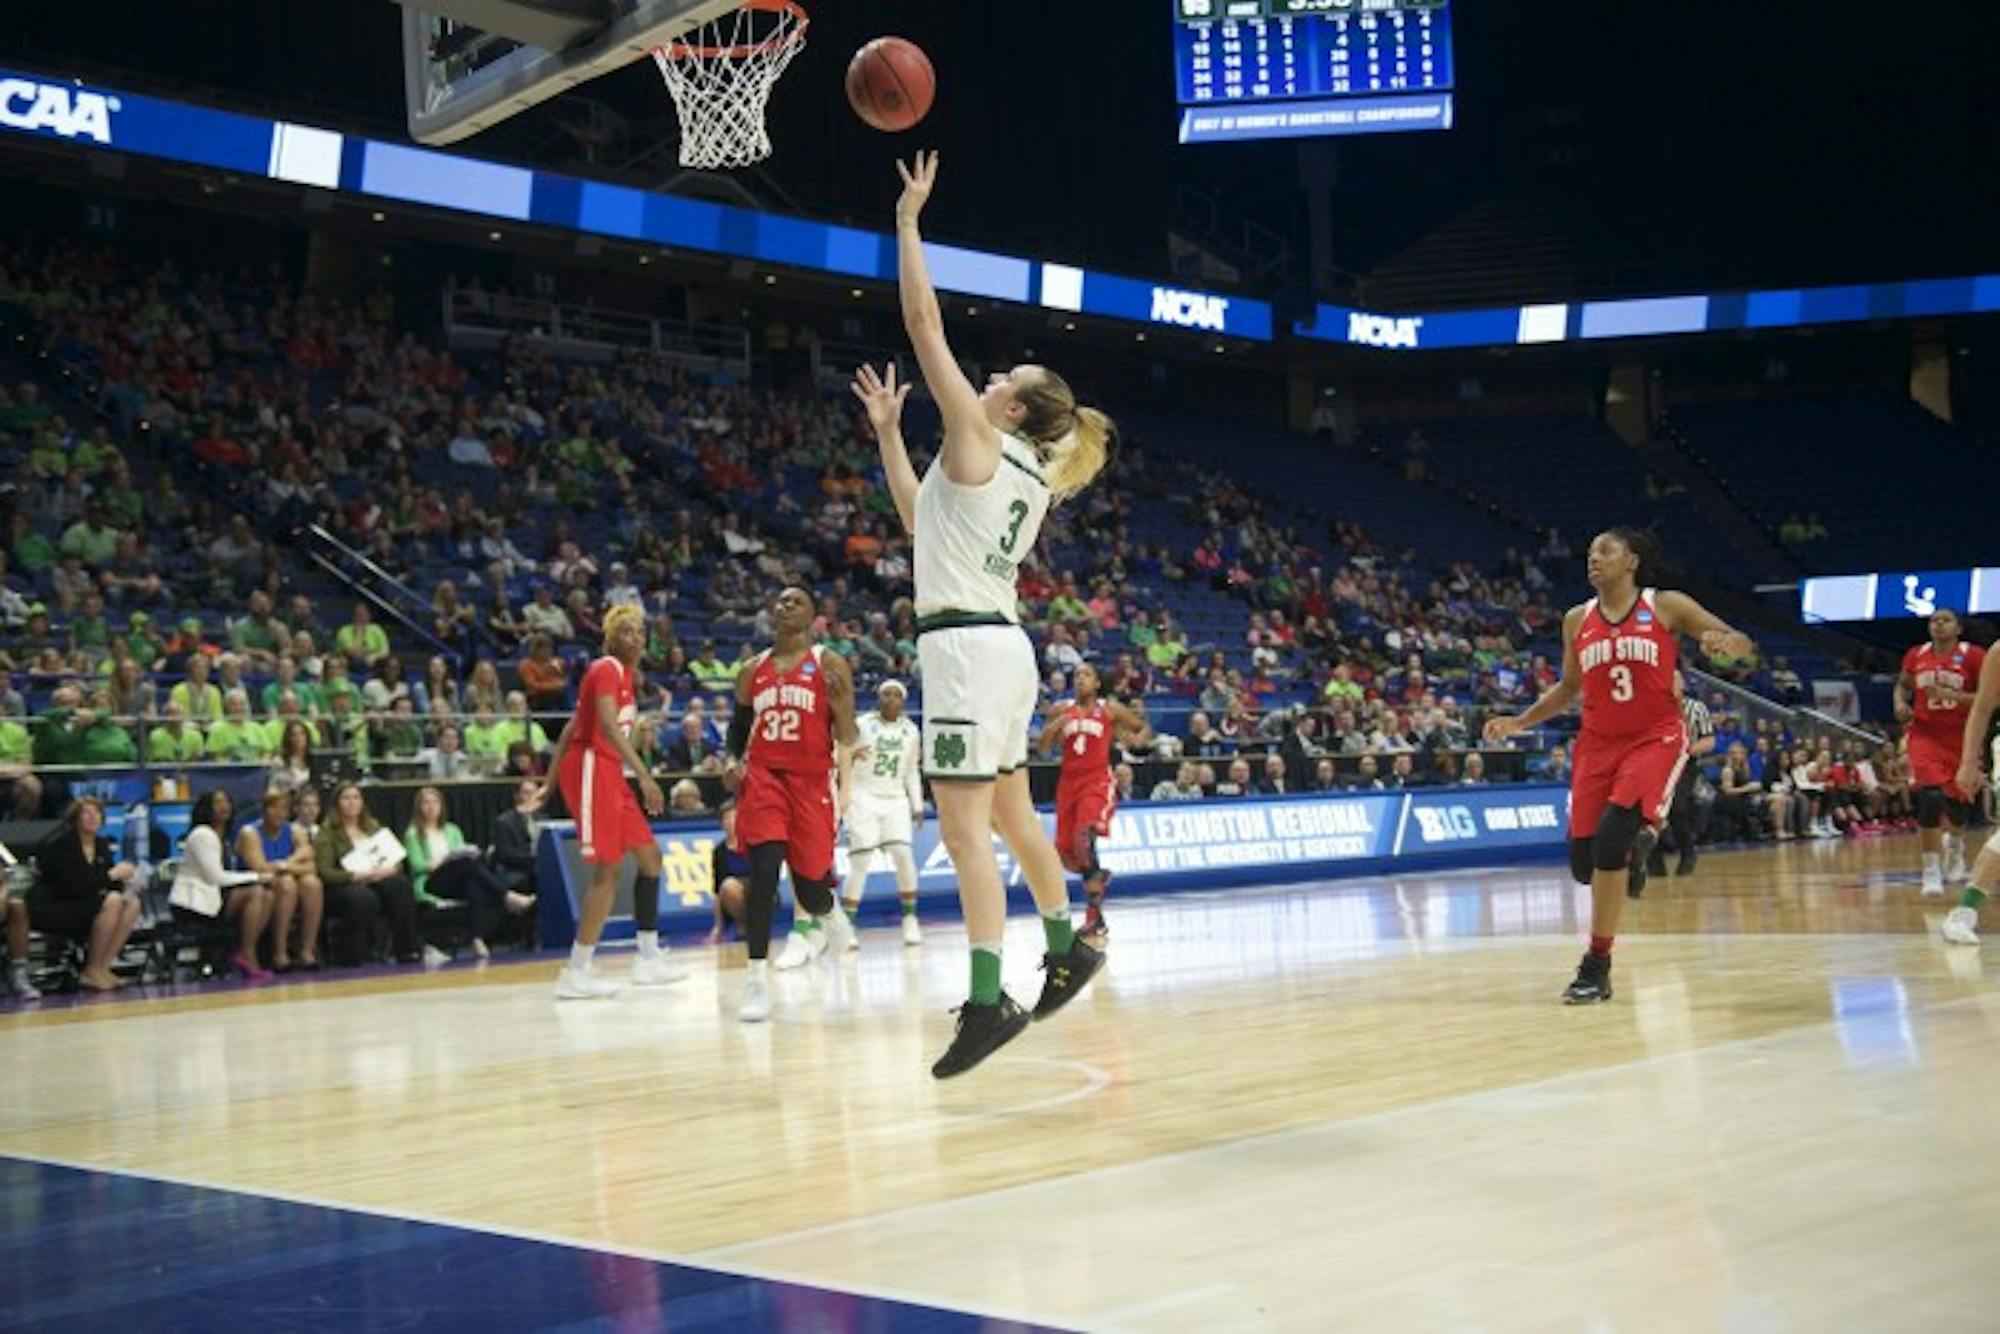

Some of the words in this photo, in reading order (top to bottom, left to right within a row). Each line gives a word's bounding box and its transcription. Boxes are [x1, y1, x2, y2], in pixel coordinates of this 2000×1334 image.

[1150, 287, 1225, 331] NCAA
[1348, 312, 1418, 349] NCAA
[999, 499, 1029, 554] 3
[1580, 638, 1611, 674] OHIO
[1616, 636, 1659, 668] STATE
[780, 684, 817, 713] STATE
[1610, 665, 1633, 703] 3
[761, 709, 800, 742] 32
[1072, 733, 1087, 756] 4
[873, 753, 900, 778] 24
[1143, 808, 1271, 847] LEXINGTON
[1271, 803, 1375, 840] REGIONAL
[1518, 804, 1559, 828] STATE
